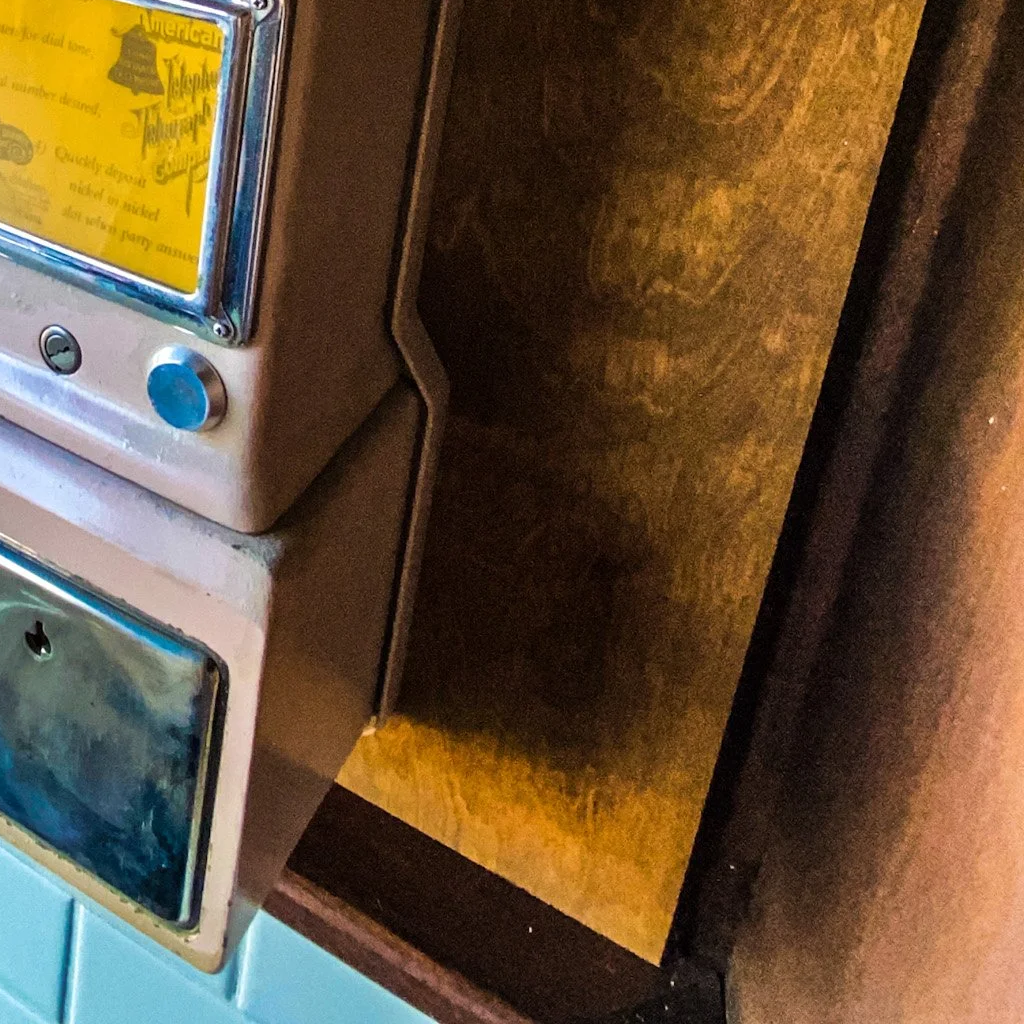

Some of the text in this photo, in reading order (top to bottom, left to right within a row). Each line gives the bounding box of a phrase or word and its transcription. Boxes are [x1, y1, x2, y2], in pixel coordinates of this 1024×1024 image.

[41, 33, 66, 49] dial
[139, 9, 222, 52] American
[11, 81, 57, 101] number
[54, 145, 102, 174] Quickly
[105, 163, 147, 189] deposit
[69, 180, 161, 222] nickel in nickel
[119, 229, 154, 252] party
